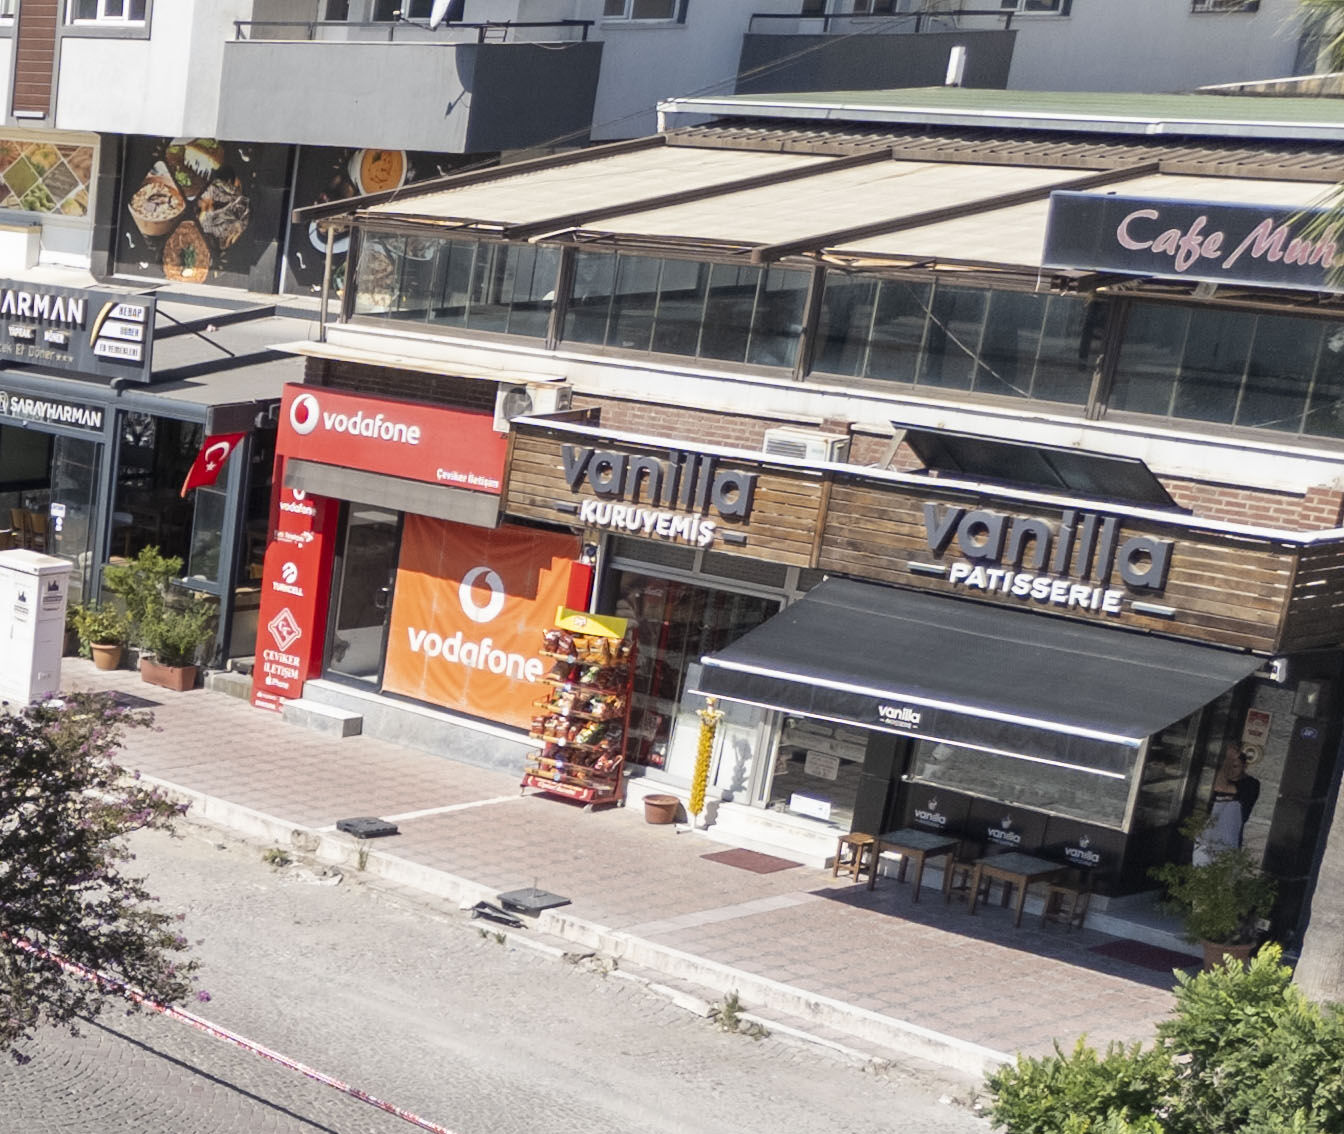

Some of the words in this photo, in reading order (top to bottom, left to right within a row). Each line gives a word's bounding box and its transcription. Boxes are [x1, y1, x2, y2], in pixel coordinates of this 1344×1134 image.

[1116, 208, 1225, 273] Cafe
[1221, 217, 1339, 270] Muh
[9, 396, 102, 428] SARAYHARMAN
[322, 411, 422, 445] vodafone
[561, 443, 759, 520] vanilla
[579, 499, 718, 548] KURUYEMİŞ
[922, 502, 1175, 591] vanilla
[948, 561, 1126, 614] PATISSERIE
[407, 626, 545, 683] vodafone
[877, 704, 921, 724] vanilla
[914, 808, 947, 825] vanilla
[987, 826, 1022, 845] vanilla
[1064, 847, 1100, 864] vanilla
